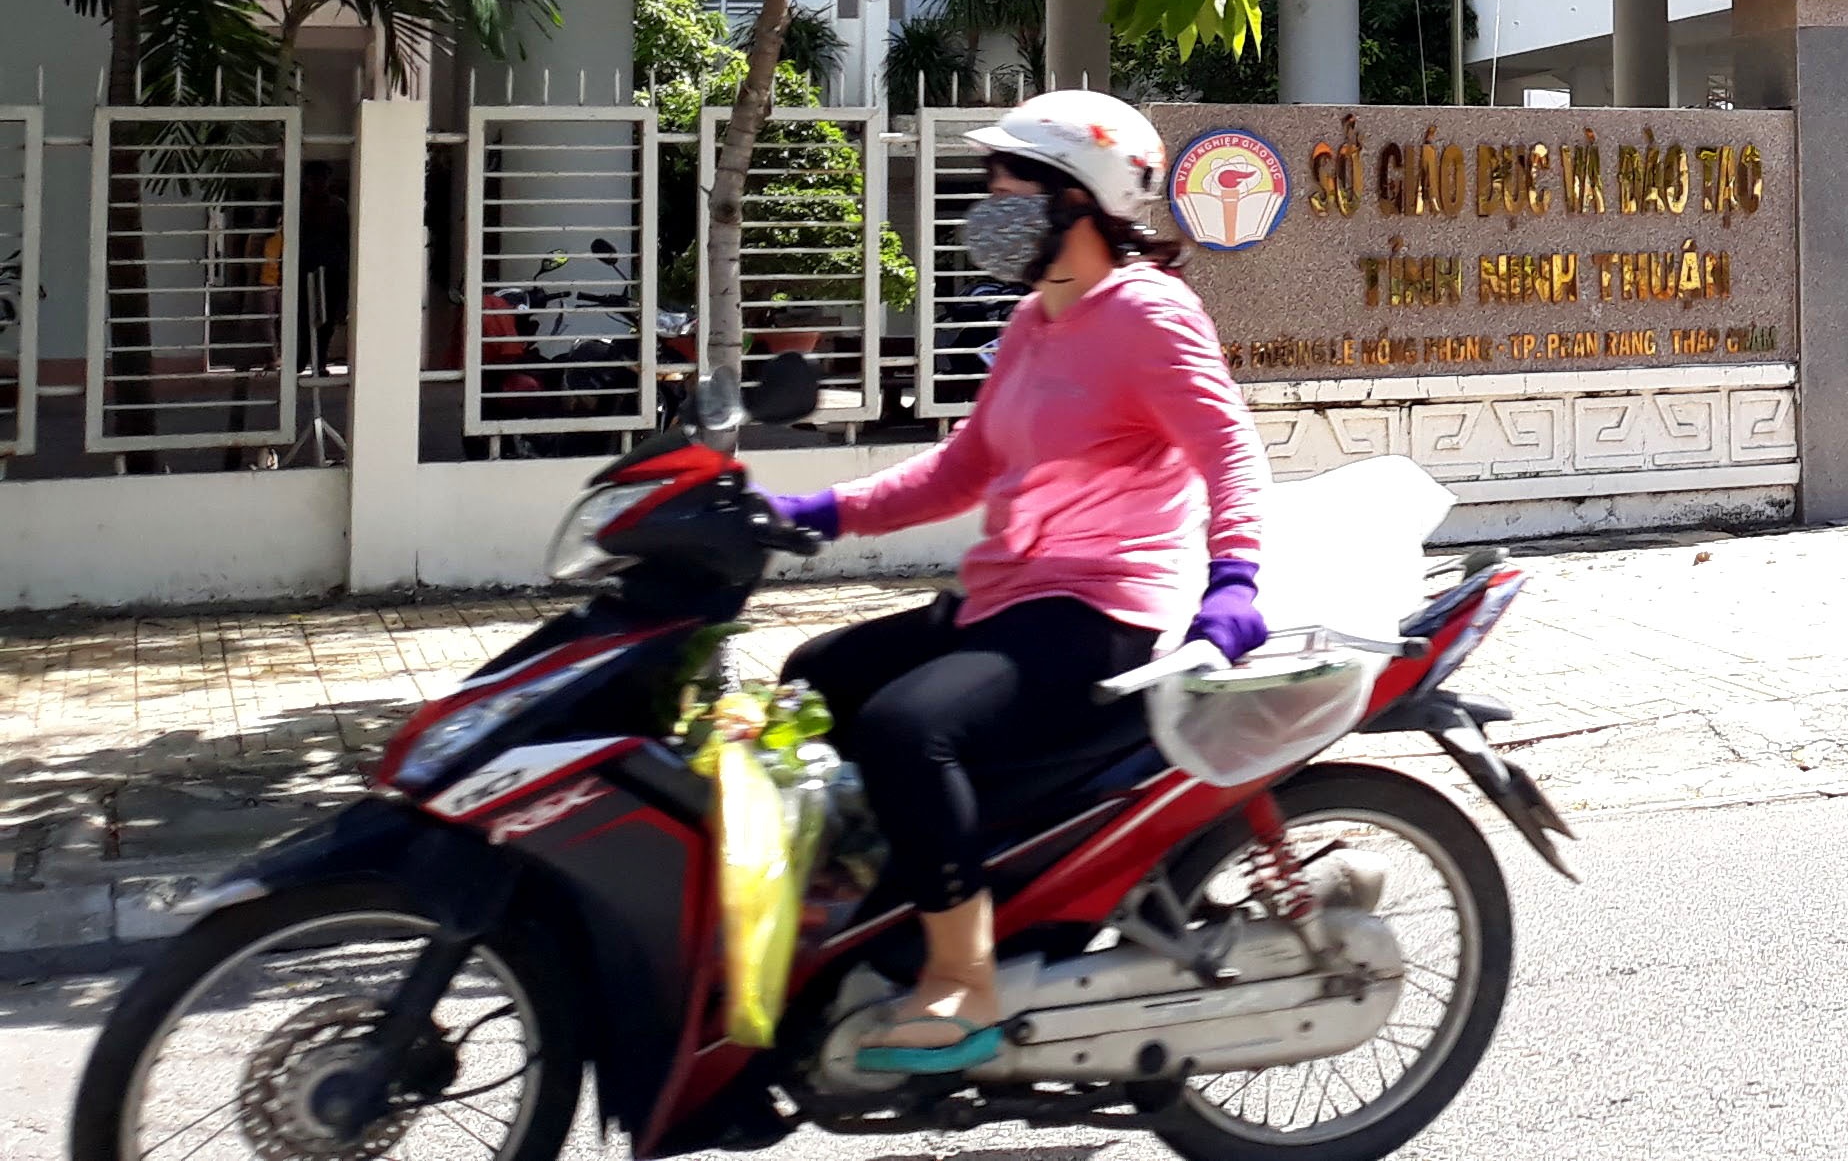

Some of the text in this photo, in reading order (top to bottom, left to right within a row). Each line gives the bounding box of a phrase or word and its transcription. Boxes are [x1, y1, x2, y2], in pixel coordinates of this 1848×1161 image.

[1197, 137, 1240, 154] NGHIỆP
[1241, 140, 1268, 158] GIÁO
[1265, 158, 1282, 180] DỤC
[1309, 113, 1764, 231] SỞ GIÁO DỤC VÀ ĐÀO TẠO
[1358, 235, 1732, 310] TỈNH NINH THUẬN
[1423, 334, 1495, 364] PHONG
[1605, 329, 1657, 358] RANG
